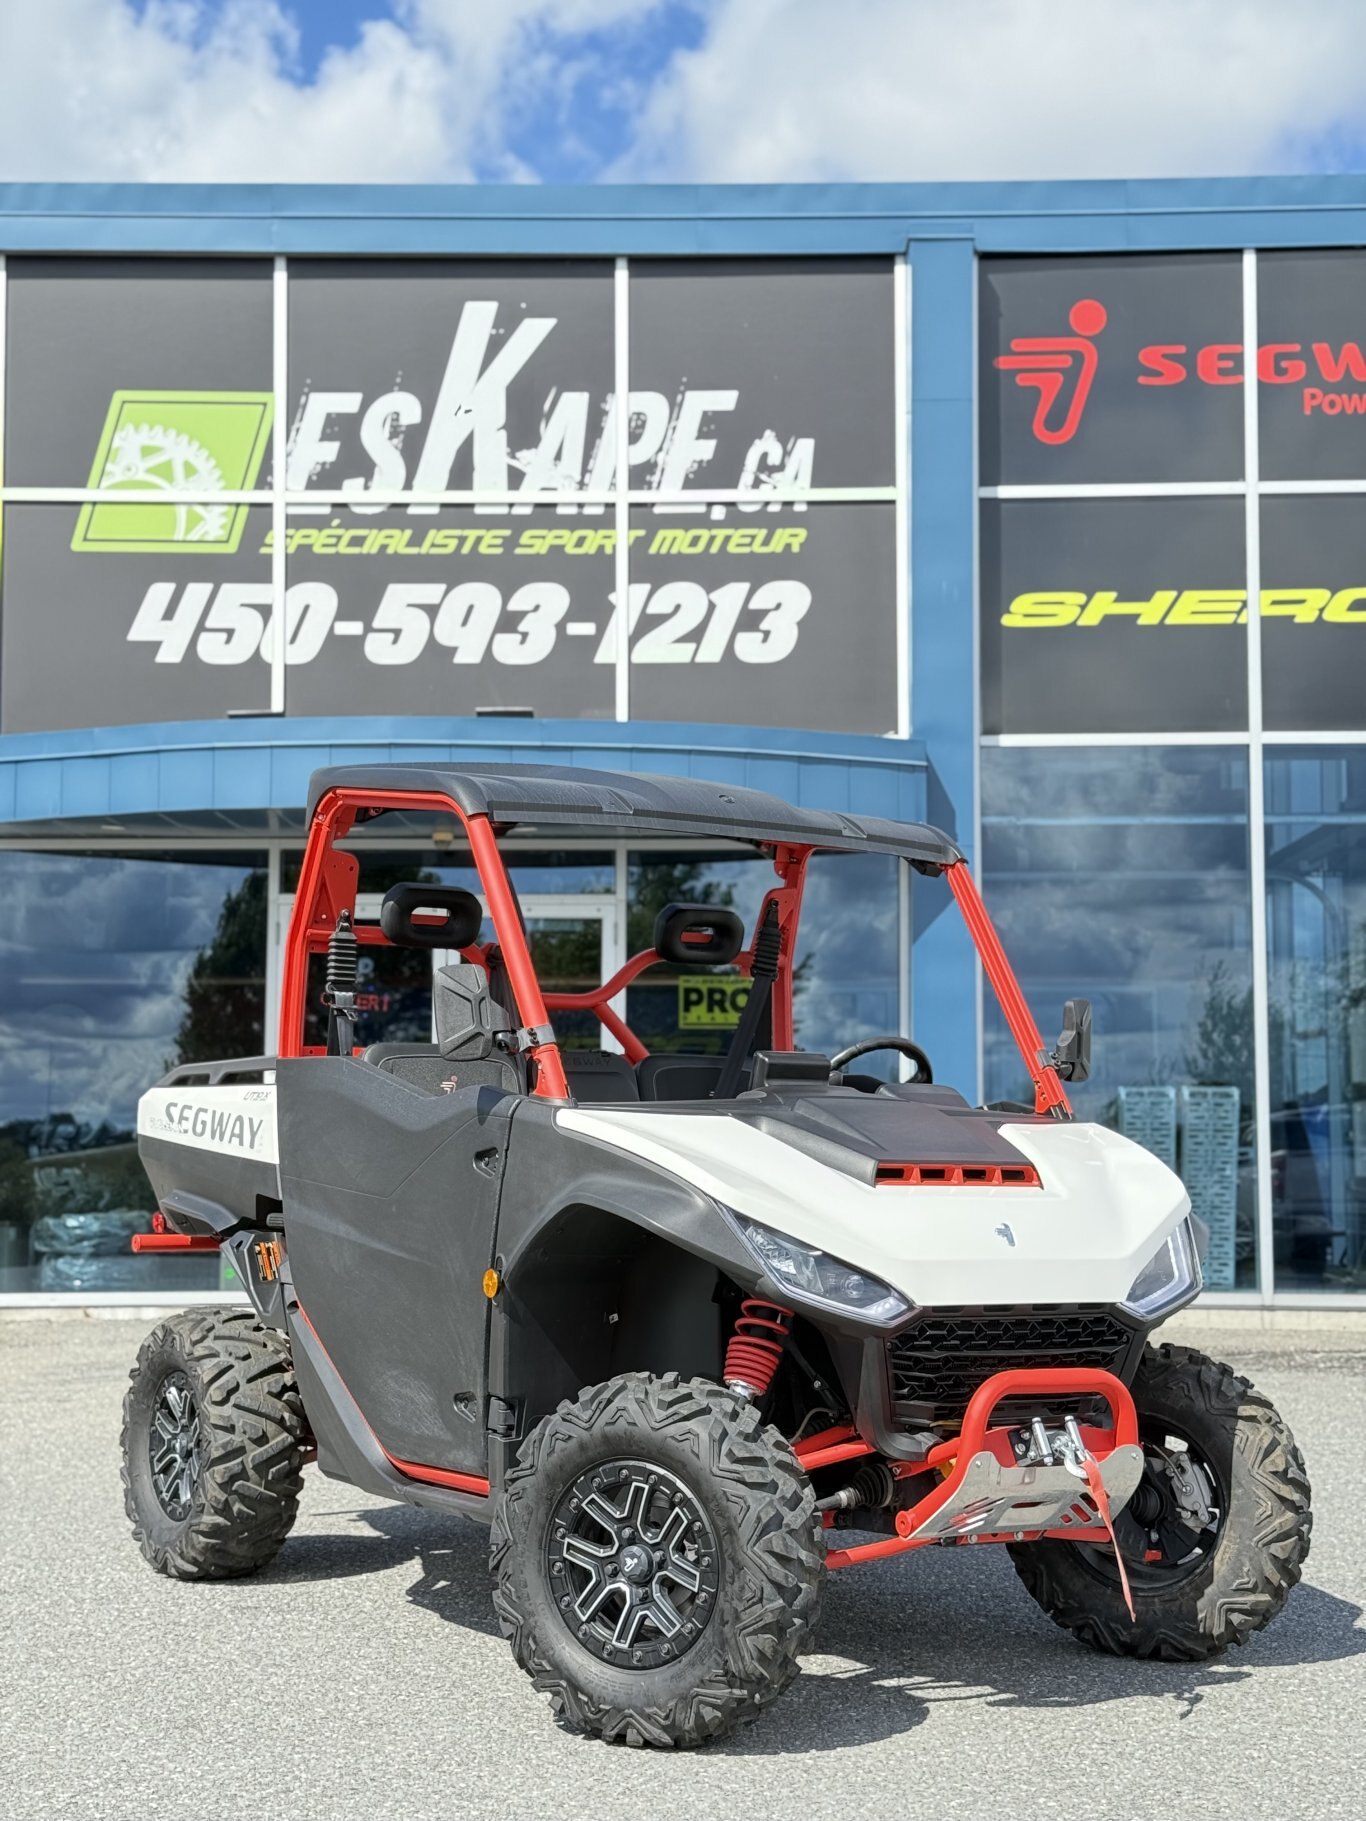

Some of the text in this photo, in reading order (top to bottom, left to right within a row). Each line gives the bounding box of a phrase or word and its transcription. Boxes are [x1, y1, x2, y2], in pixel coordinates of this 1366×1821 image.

[259, 518, 511, 554] SPÉCIALISTE
[648, 528, 807, 554] MOTEUR
[126, 581, 812, 665] 450-593-1213
[165, 1101, 263, 1150] SEGWAY
